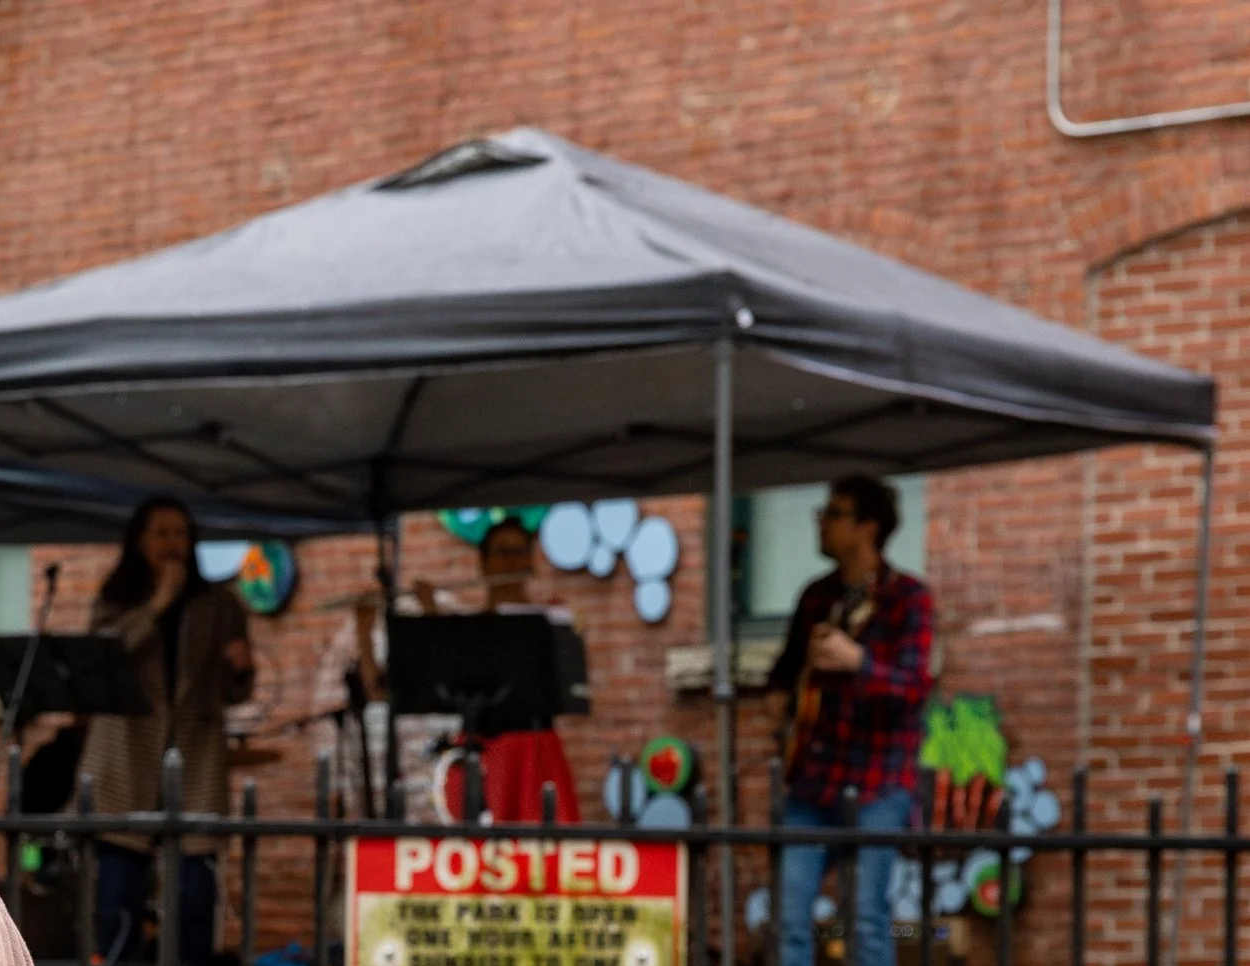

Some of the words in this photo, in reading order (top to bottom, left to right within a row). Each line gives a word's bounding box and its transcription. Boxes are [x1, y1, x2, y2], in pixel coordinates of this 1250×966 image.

[393, 837, 641, 893] POSTED
[398, 902, 440, 921] THE
[457, 902, 519, 922] PARK
[535, 904, 559, 924] IS
[574, 904, 638, 925] OPEN
[406, 928, 449, 946] ONE
[468, 929, 535, 947] HOUR
[549, 930, 625, 948] AFTER
